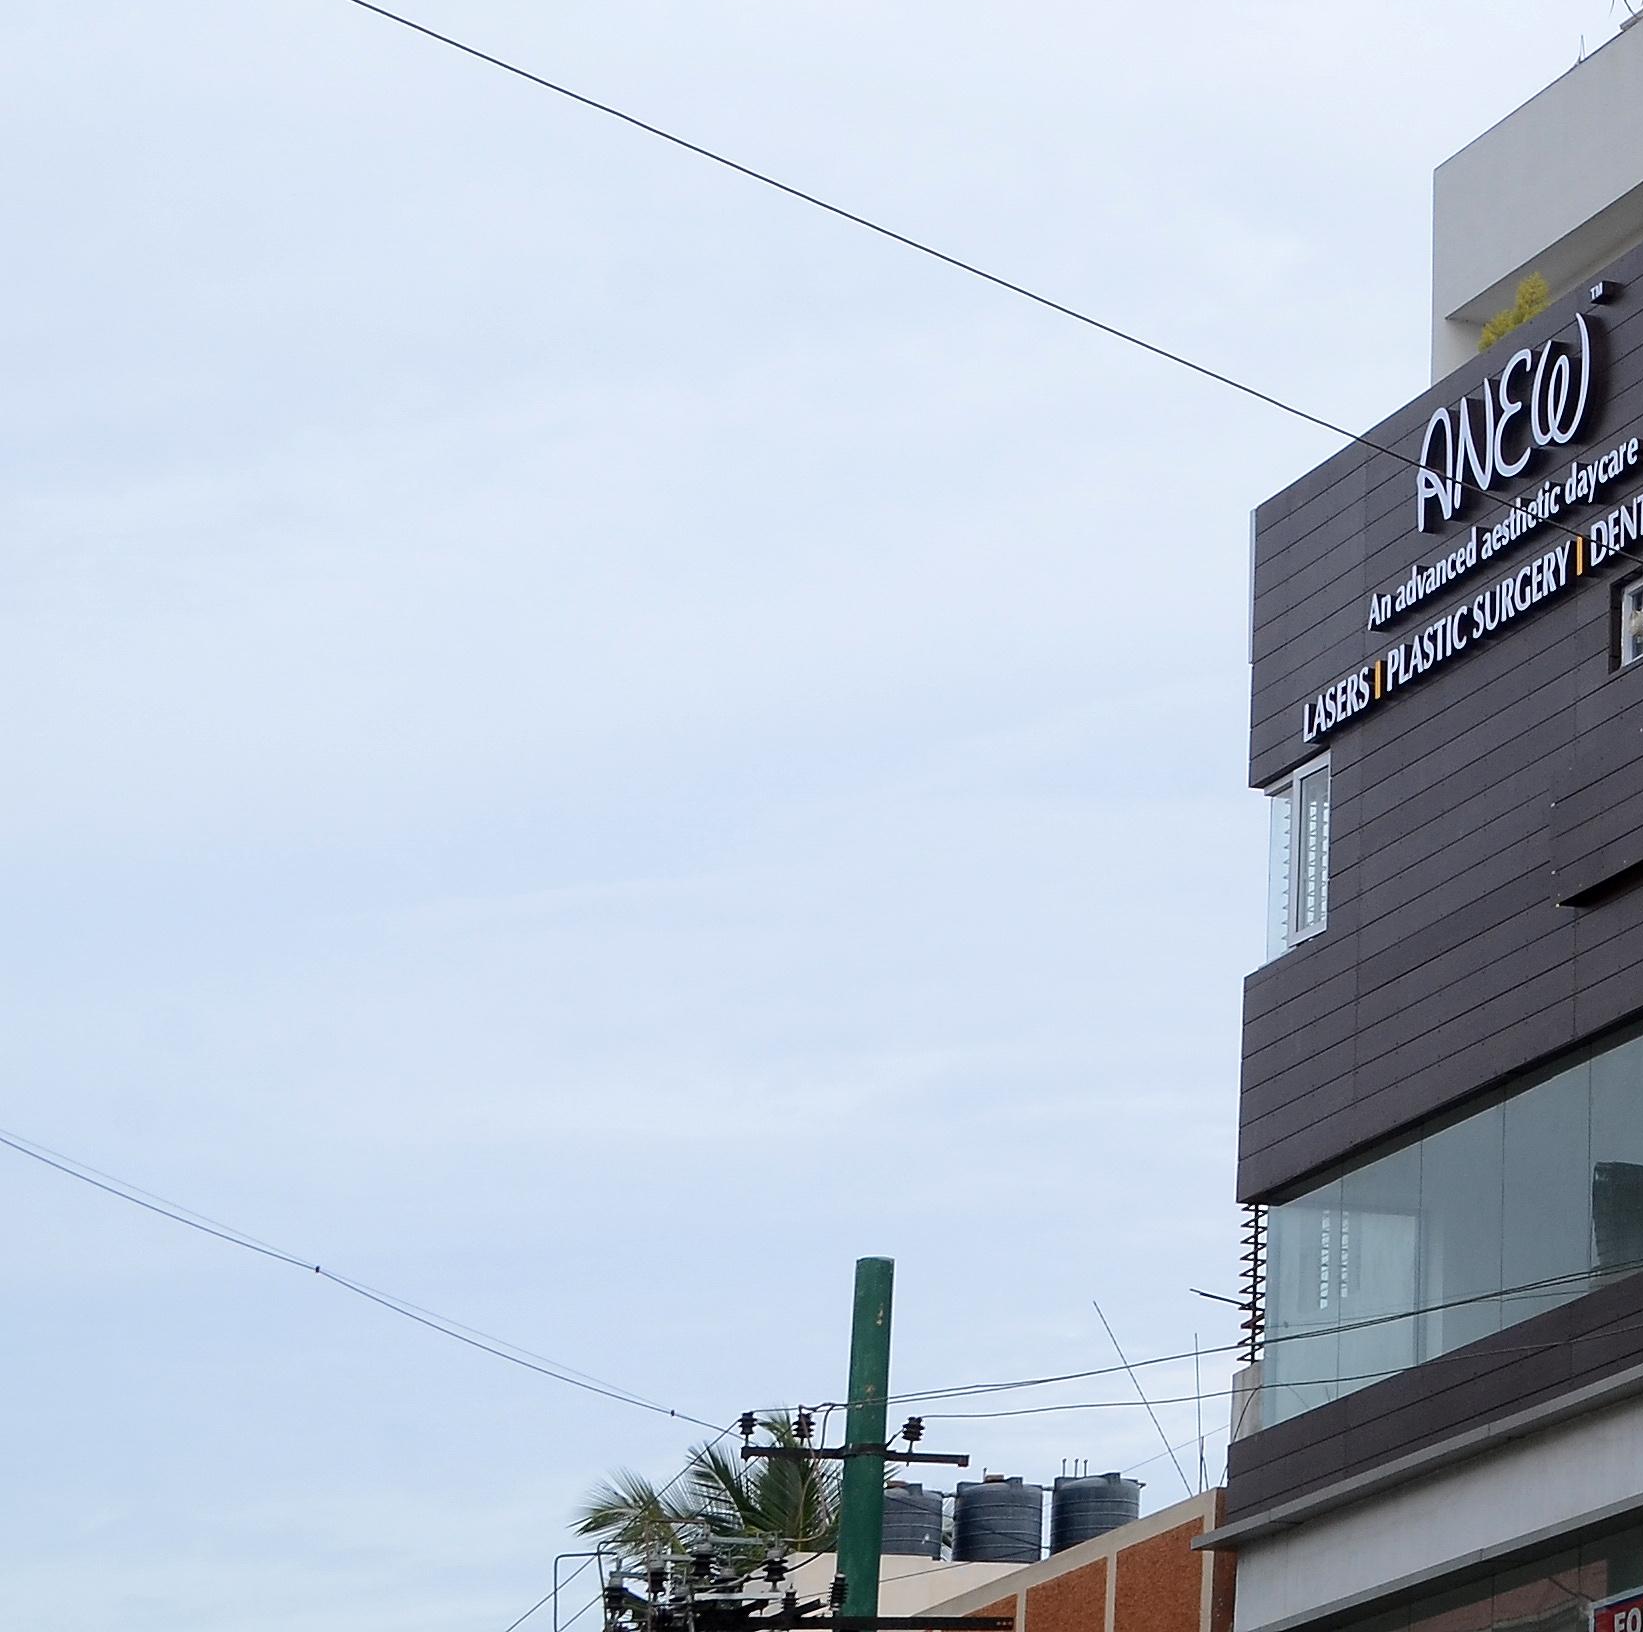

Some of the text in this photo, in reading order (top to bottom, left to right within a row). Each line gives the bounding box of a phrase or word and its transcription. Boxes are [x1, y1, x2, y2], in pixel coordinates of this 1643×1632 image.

[1417, 312, 1590, 532] ANEW
[1367, 437, 1639, 631] An advanced aesthetic daycare
[1303, 666, 1370, 743] LASERS
[1386, 605, 1468, 692] PLASTIC
[1472, 540, 1574, 639] SURGERY
